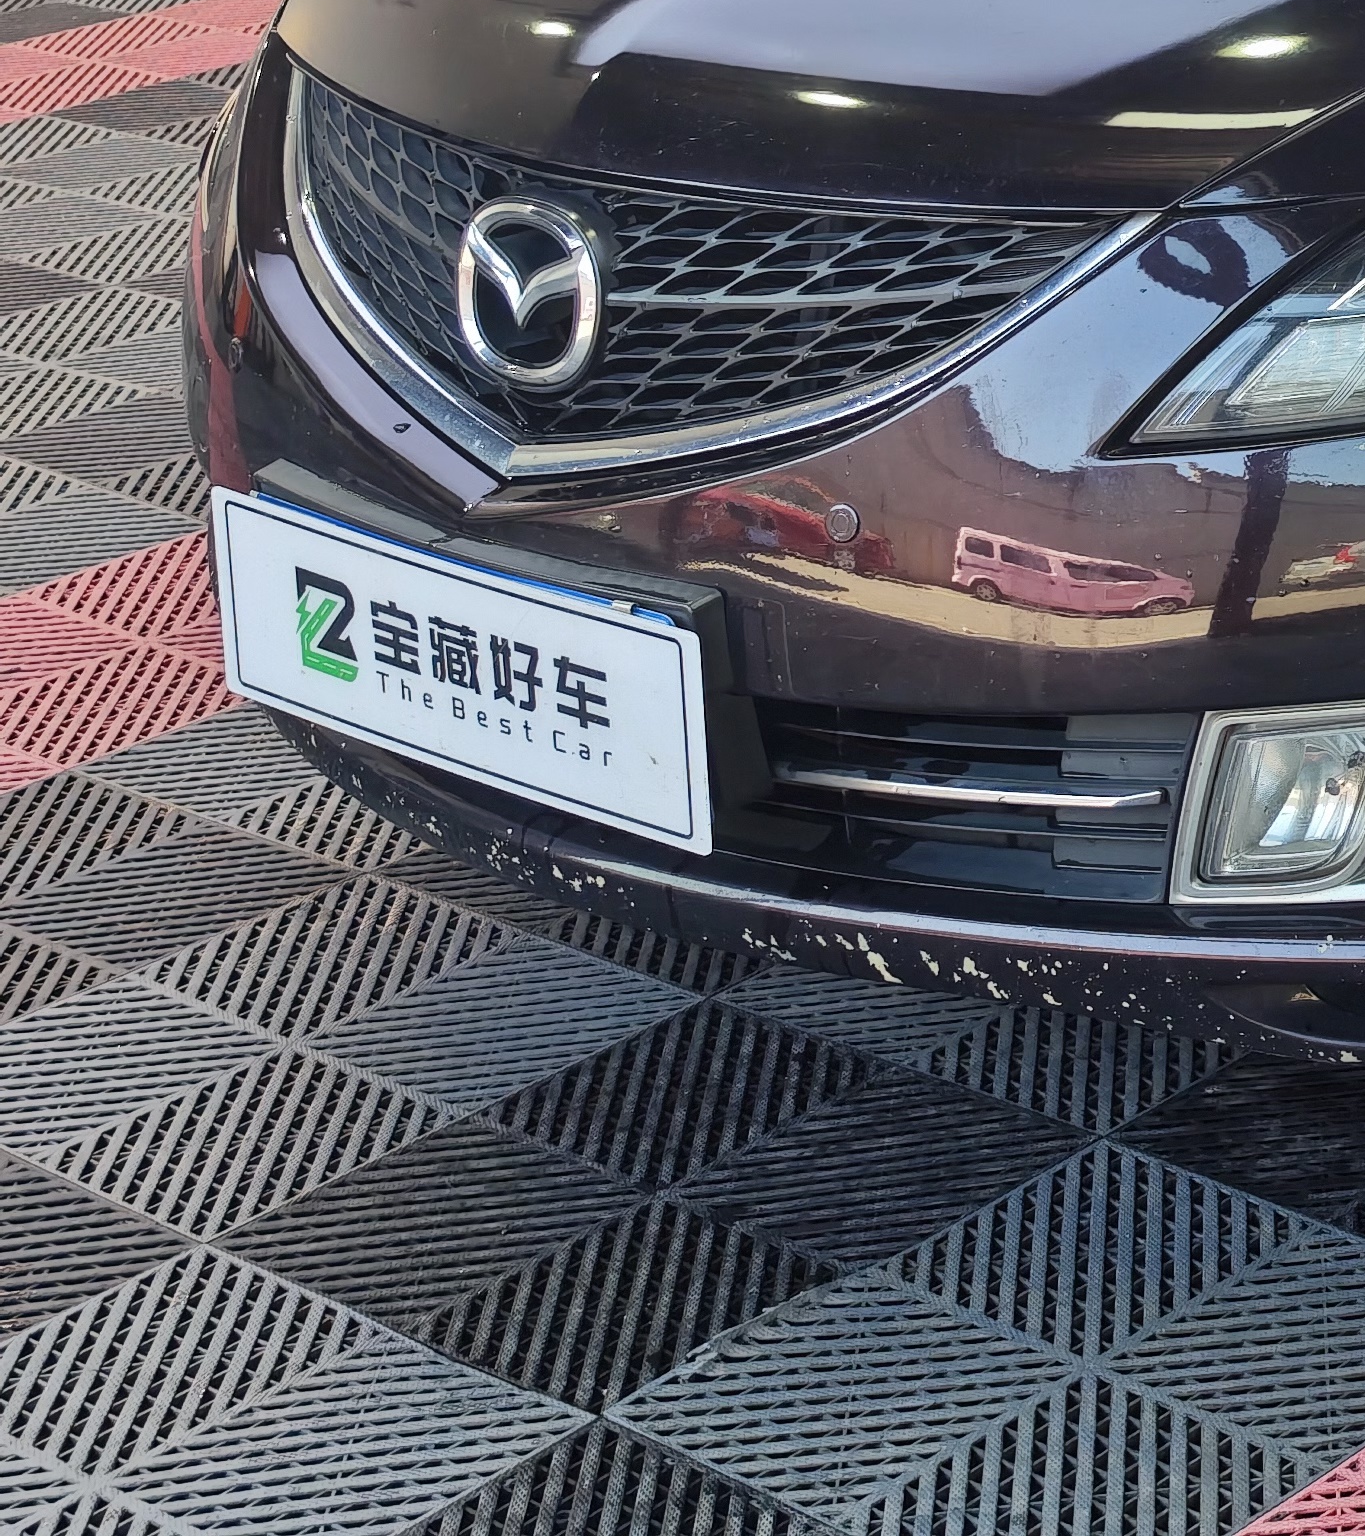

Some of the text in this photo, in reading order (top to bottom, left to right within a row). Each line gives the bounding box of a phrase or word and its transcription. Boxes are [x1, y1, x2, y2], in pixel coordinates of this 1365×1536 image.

[369, 599, 611, 730] 宝藏好车
[375, 670, 613, 768] The Best Car
